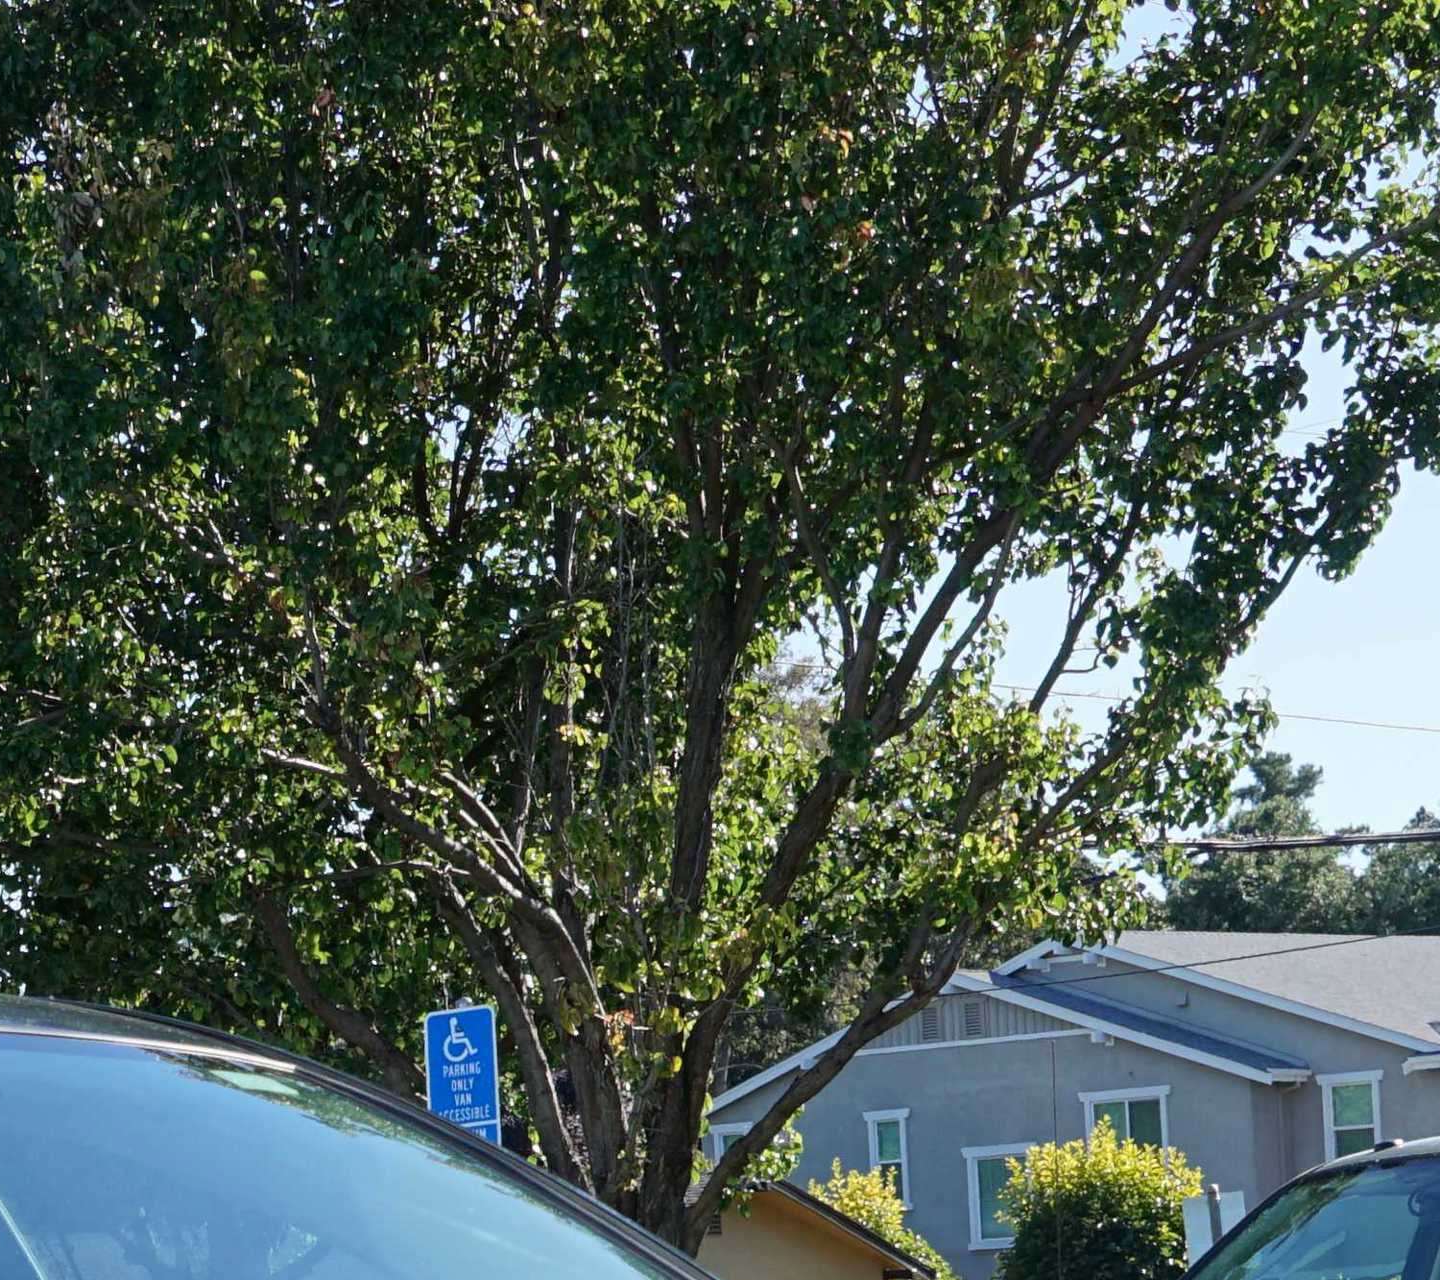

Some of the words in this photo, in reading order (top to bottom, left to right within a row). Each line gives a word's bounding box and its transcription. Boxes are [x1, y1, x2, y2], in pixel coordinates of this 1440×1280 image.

[442, 1061, 481, 1078] PARKING
[451, 1077, 474, 1092] ONLY
[454, 1093, 472, 1107] VAN
[439, 1103, 491, 1121] CCESSIBLE
